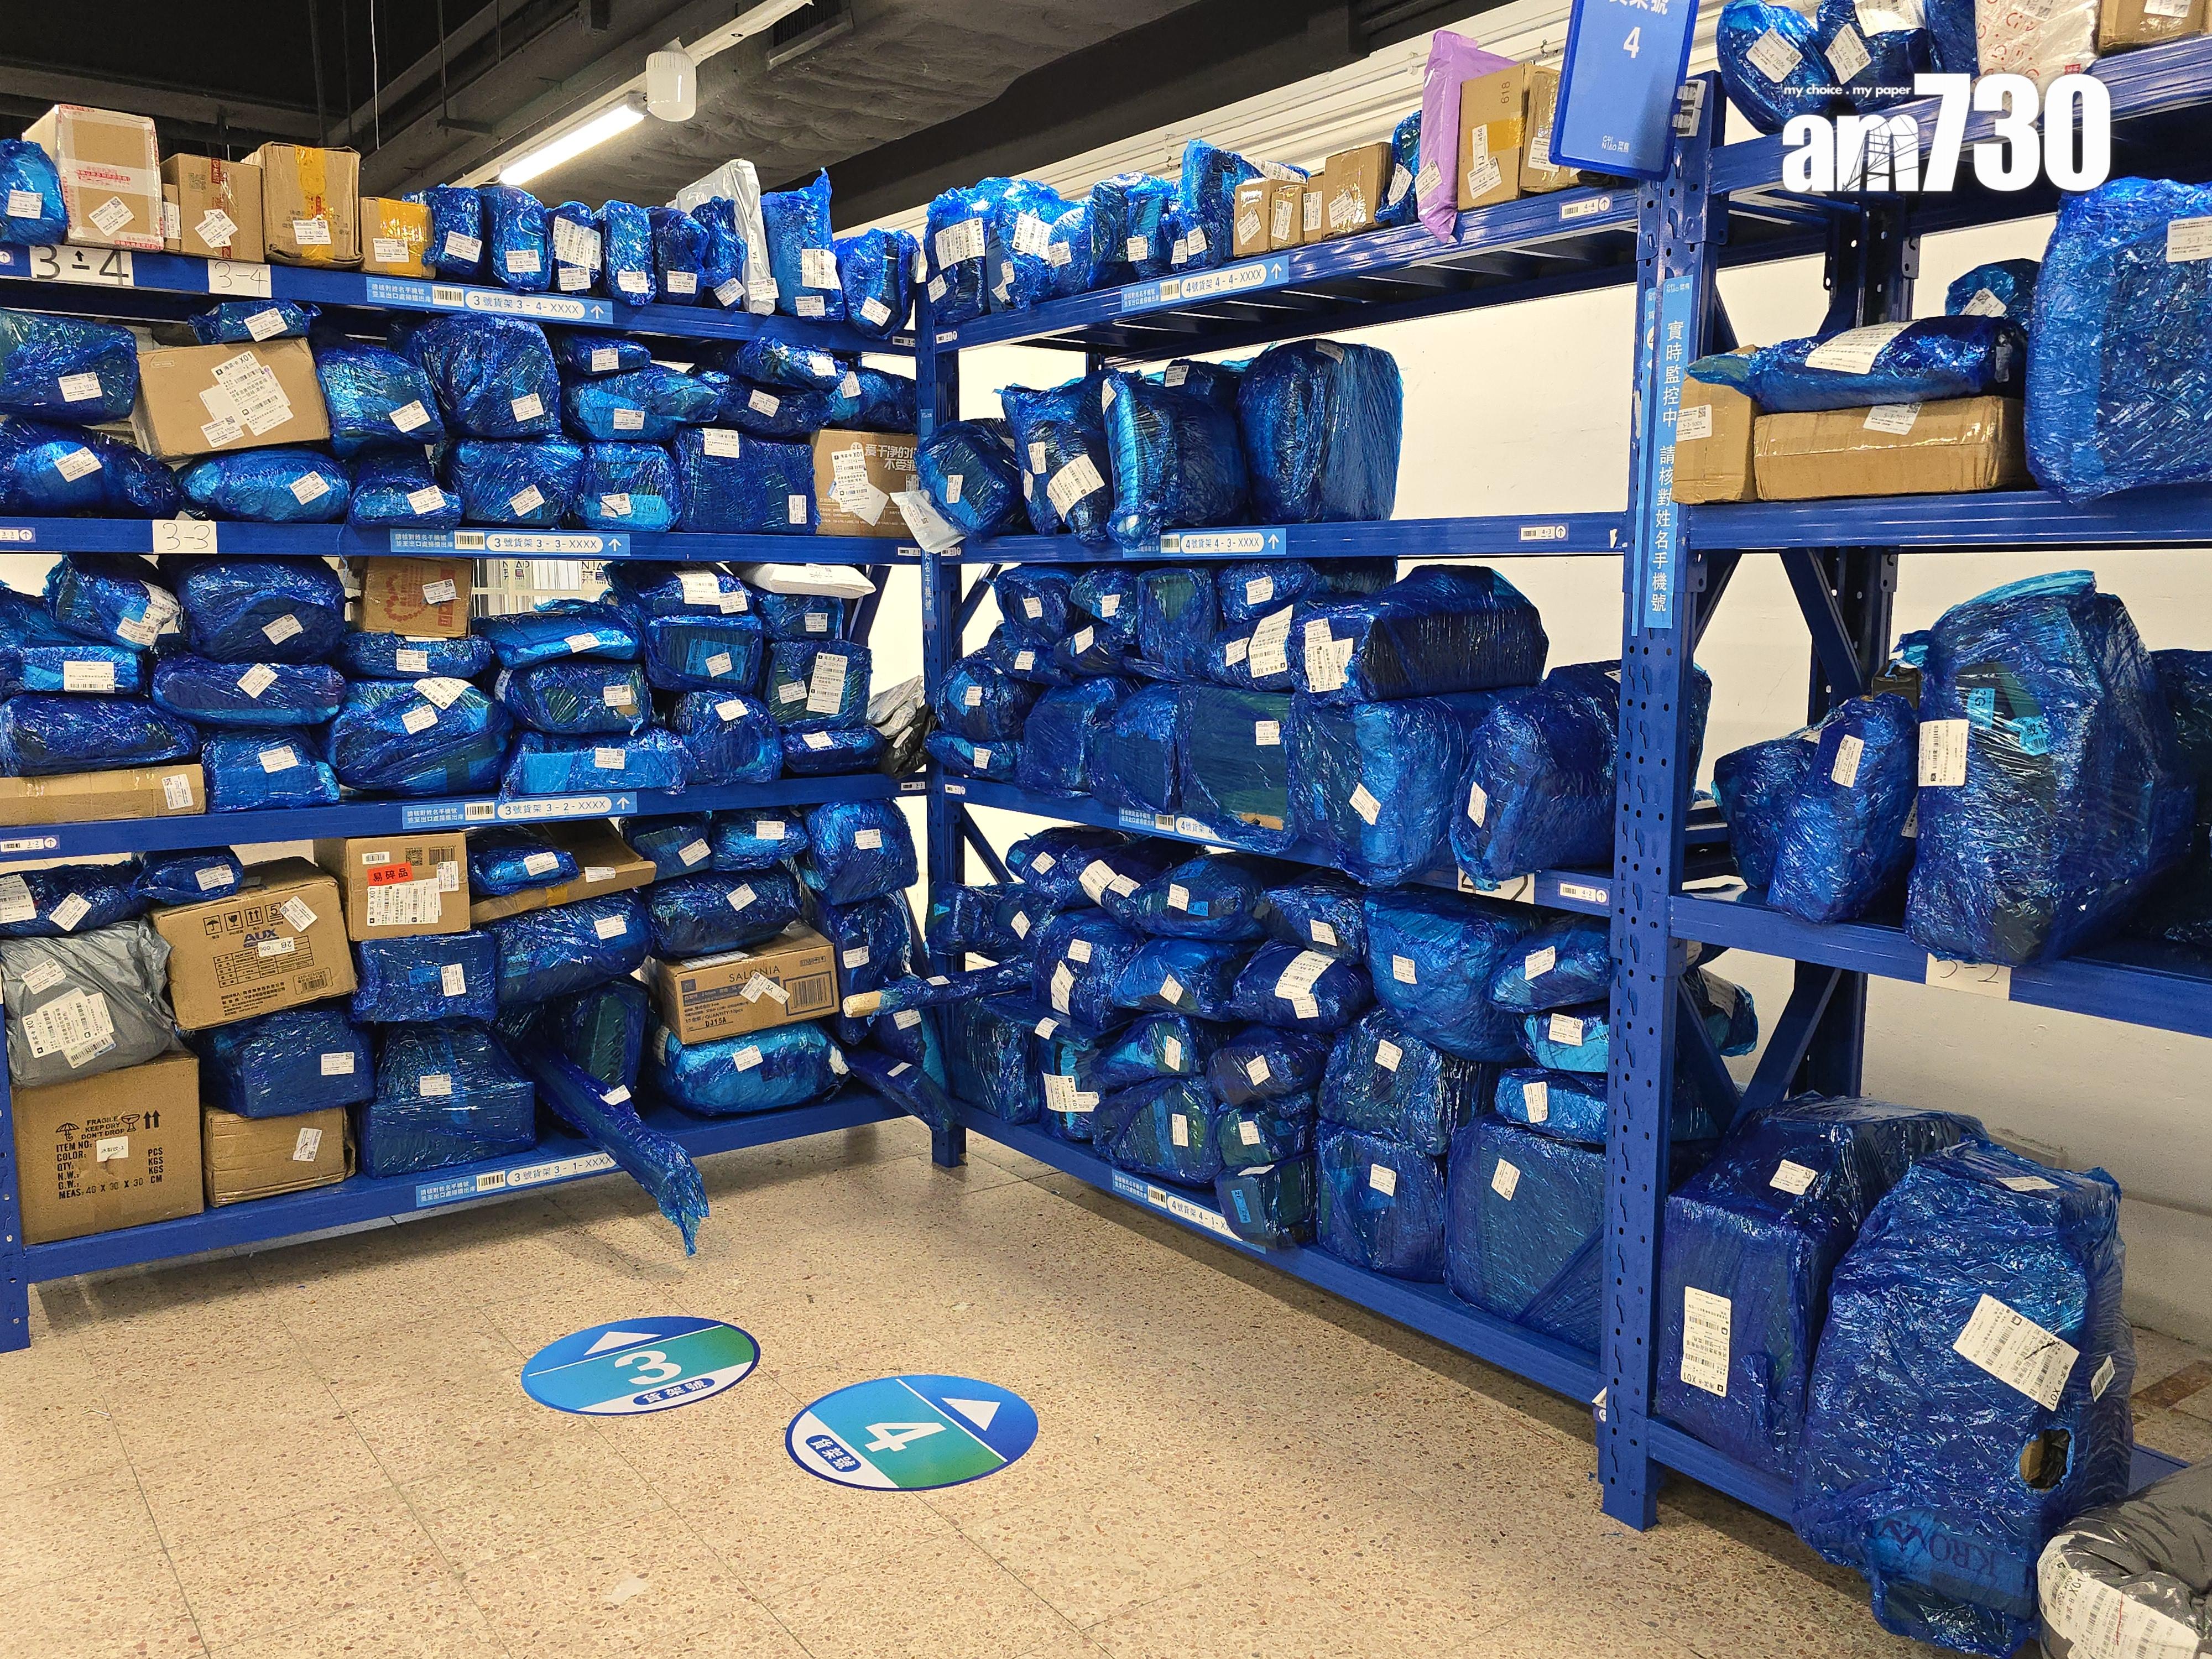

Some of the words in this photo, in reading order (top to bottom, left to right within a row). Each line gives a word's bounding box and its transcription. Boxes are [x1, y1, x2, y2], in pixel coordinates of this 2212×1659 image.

[1623, 27, 1641, 59] 4
[215, 262, 268, 294] 3-4
[1662, 321, 1684, 428] 實時監控中
[1652, 446, 1676, 612] 請核對姓名手機號
[163, 523, 210, 550] 3-3
[373, 868, 408, 882] 易碎品
[244, 928, 278, 942] AUX
[25, 1016, 35, 1030] X01
[705, 1017, 727, 1028] DJ15A
[87, 1116, 118, 1125] FRAGILE
[56, 1142, 75, 1152] ITEM
[148, 1147, 163, 1157] PCS
[57, 1151, 87, 1161] COLOR:
[148, 1157, 164, 1166] KGS
[58, 1162, 74, 1171] QTY:
[149, 1165, 164, 1174] KGS
[124, 1180, 129, 1188] X
[133, 1178, 143, 1186] 30
[150, 1175, 163, 1183] CM
[614, 1350, 682, 1385] 3
[1684, 1372, 1696, 1383] X01
[643, 1380, 708, 1404] 貨架號
[2048, 1386, 2060, 1407] X01
[864, 1422, 947, 1452] 4
[811, 1438, 856, 1469] 貨架號
[2069, 1578, 2085, 1597] X01
